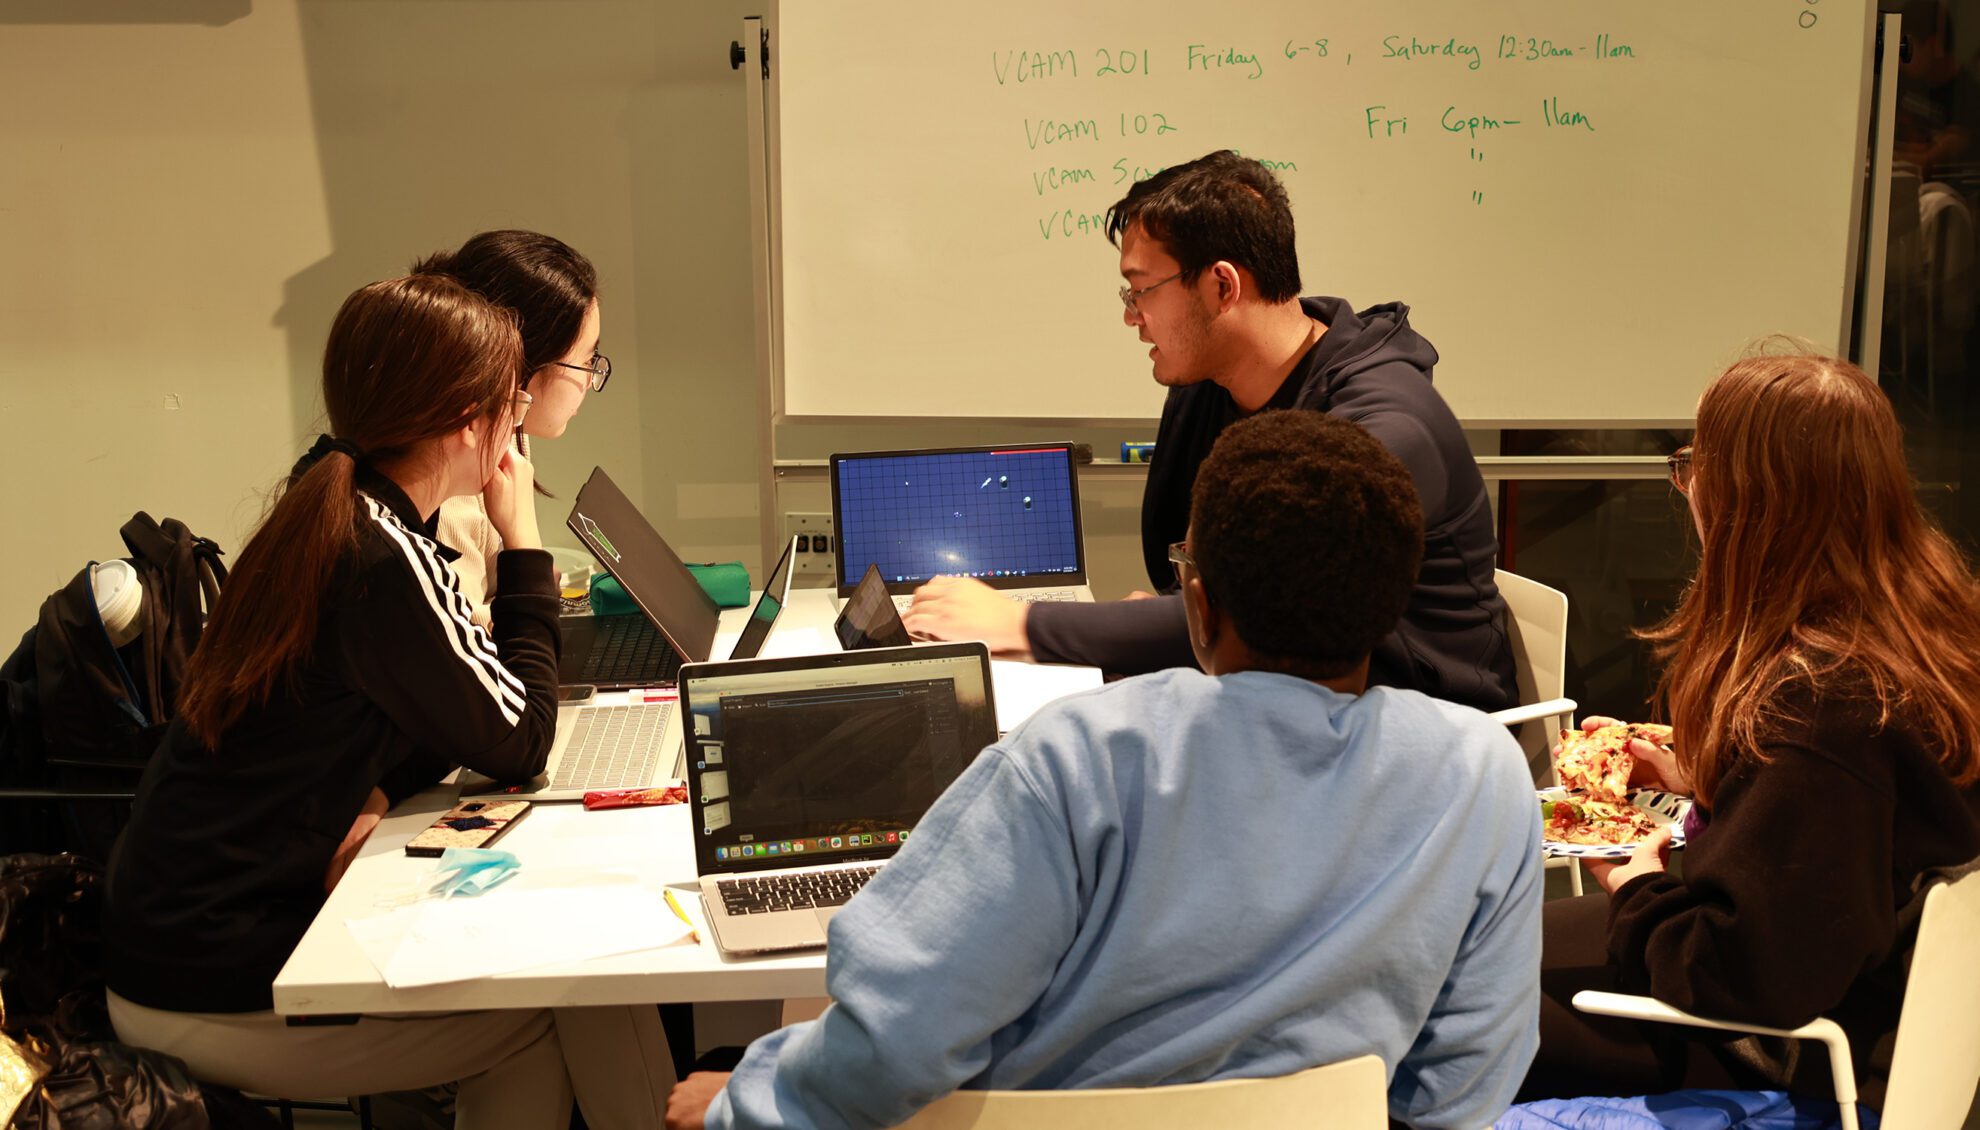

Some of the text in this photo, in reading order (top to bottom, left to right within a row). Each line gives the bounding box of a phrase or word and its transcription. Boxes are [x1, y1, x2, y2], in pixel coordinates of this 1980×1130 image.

[993, 49, 1077, 85] VCAM
[1096, 48, 1149, 76] 201
[1187, 45, 1263, 80] Friday
[1382, 36, 1481, 70] Saturday
[1024, 118, 1099, 151] VCAM
[1120, 113, 1178, 137] 102
[1365, 105, 1408, 139] Fri
[1033, 165, 1096, 196] VCAM
